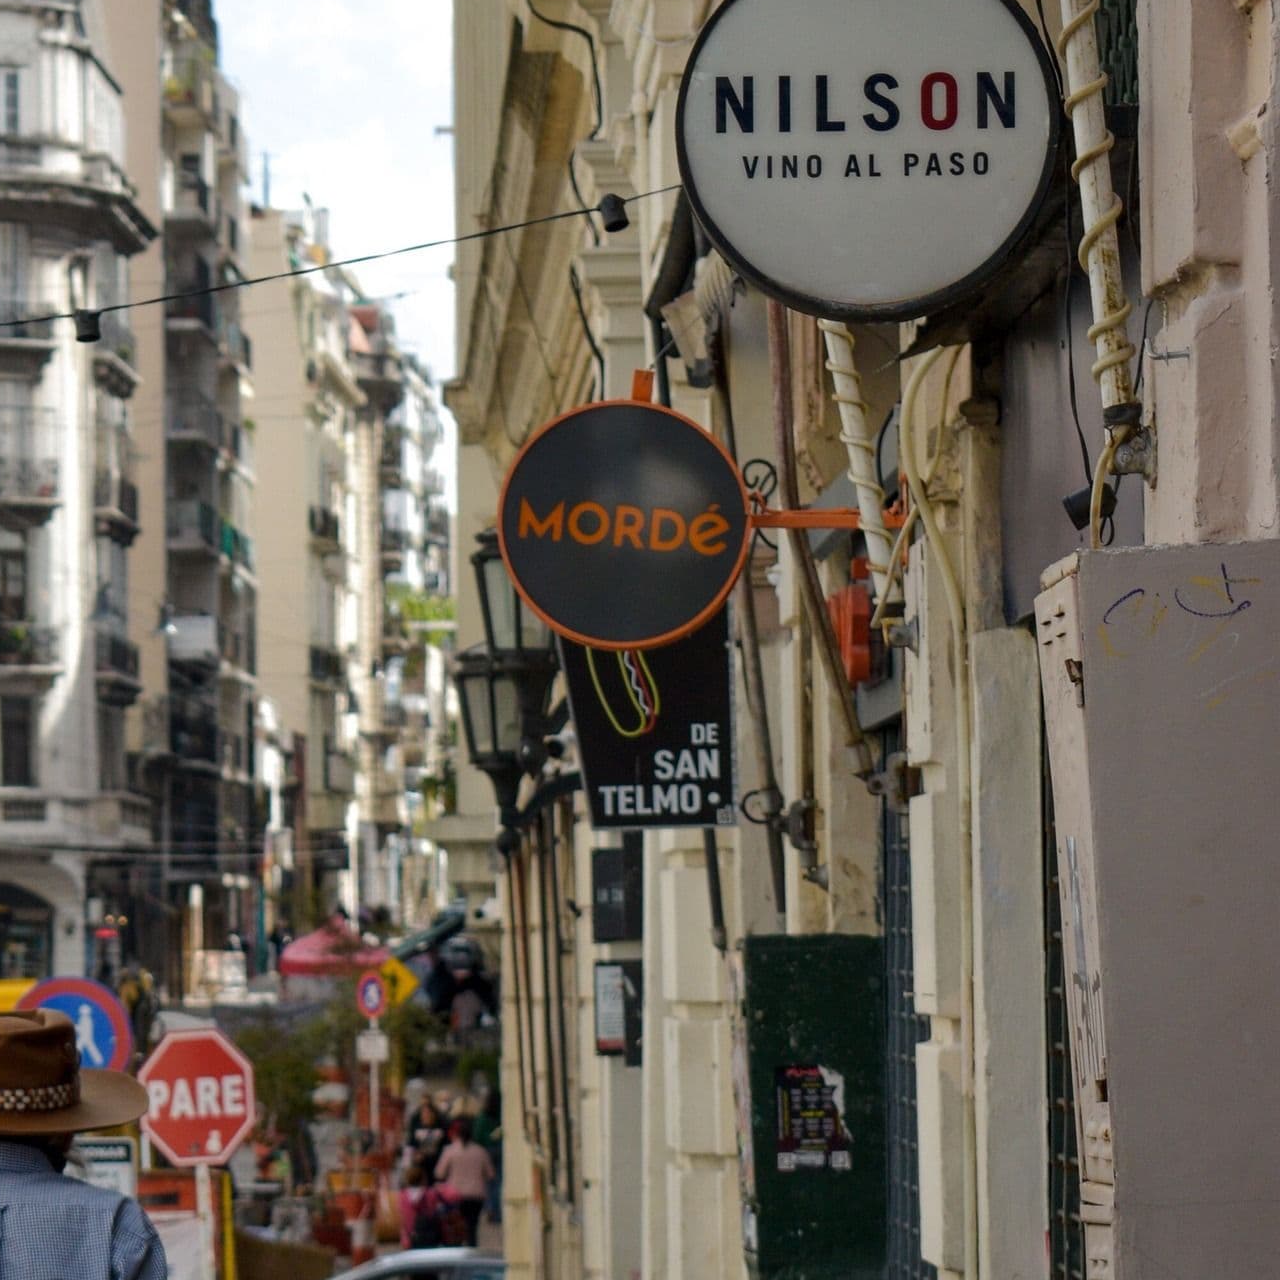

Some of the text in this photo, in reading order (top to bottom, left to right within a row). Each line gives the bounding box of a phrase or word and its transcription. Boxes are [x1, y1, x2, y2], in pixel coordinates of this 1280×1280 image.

[715, 71, 1016, 134] NILSON
[742, 151, 989, 179] VINO AL PASO
[690, 722, 719, 745] DE
[654, 749, 719, 780] SAN
[598, 783, 702, 816] TELMO
[147, 1074, 245, 1120] PARE
